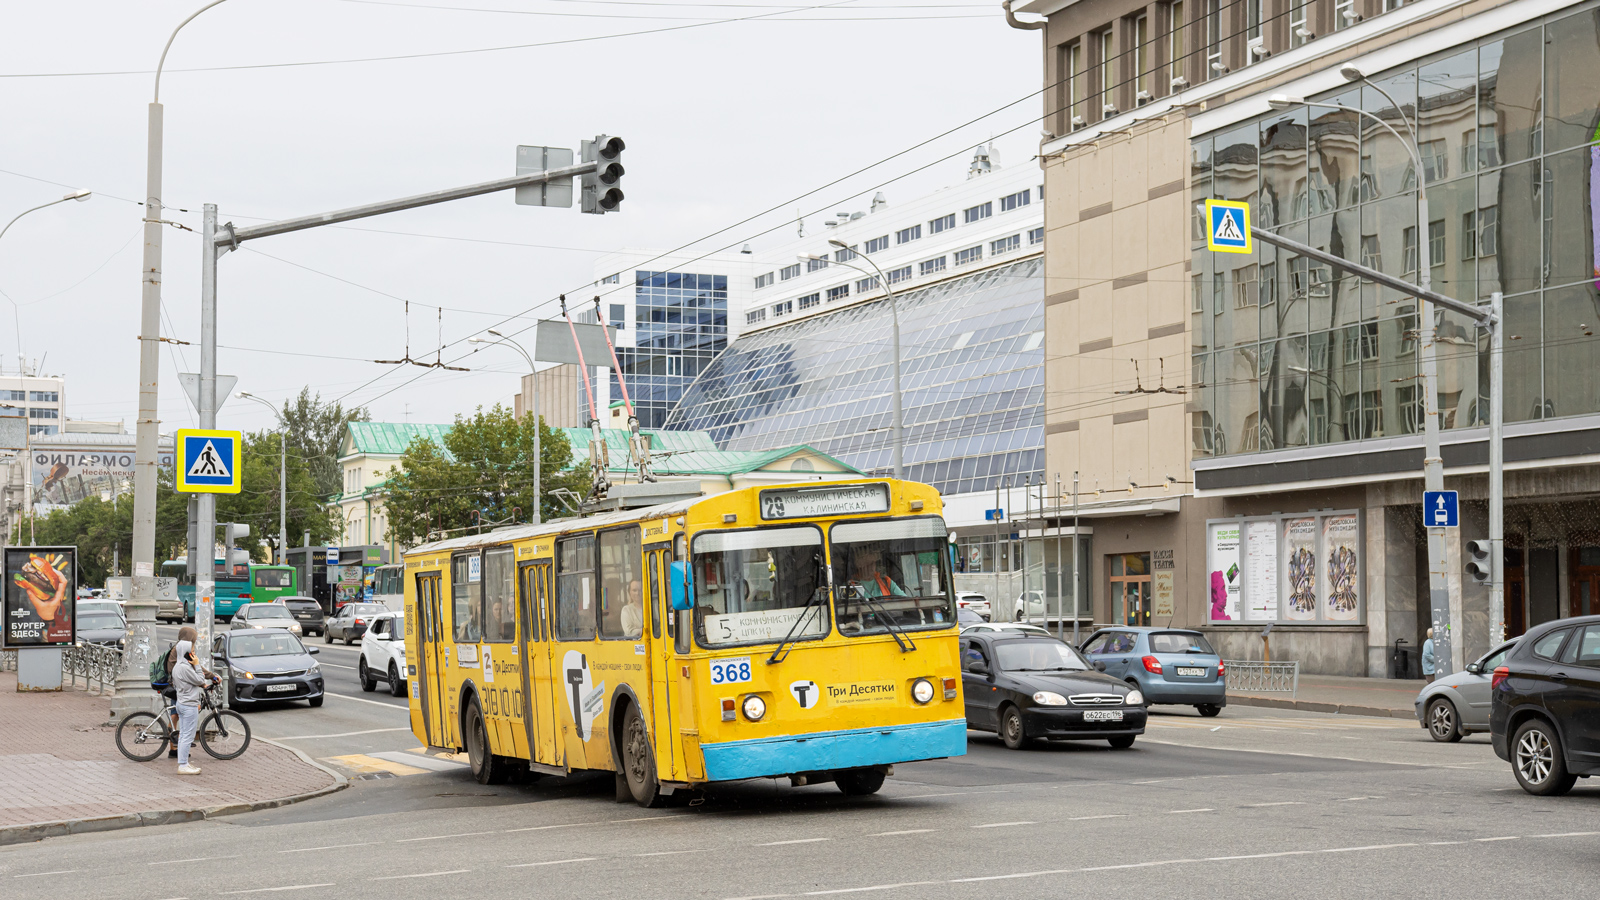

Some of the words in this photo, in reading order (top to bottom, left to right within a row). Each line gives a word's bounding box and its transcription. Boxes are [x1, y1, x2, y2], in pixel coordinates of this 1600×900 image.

[35, 453, 172, 467] ФИЛАРМОЯ
[764, 496, 786, 518] 29
[803, 501, 867, 514] КАЛИНИНСКАЯ
[11, 622, 45, 630] БУРГЕР
[11, 630, 40, 638] ЗДЕСЬ
[484, 652, 491, 669] 2
[712, 662, 751, 683] 368
[827, 686, 846, 697] Три
[849, 684, 895, 696] Десятки
